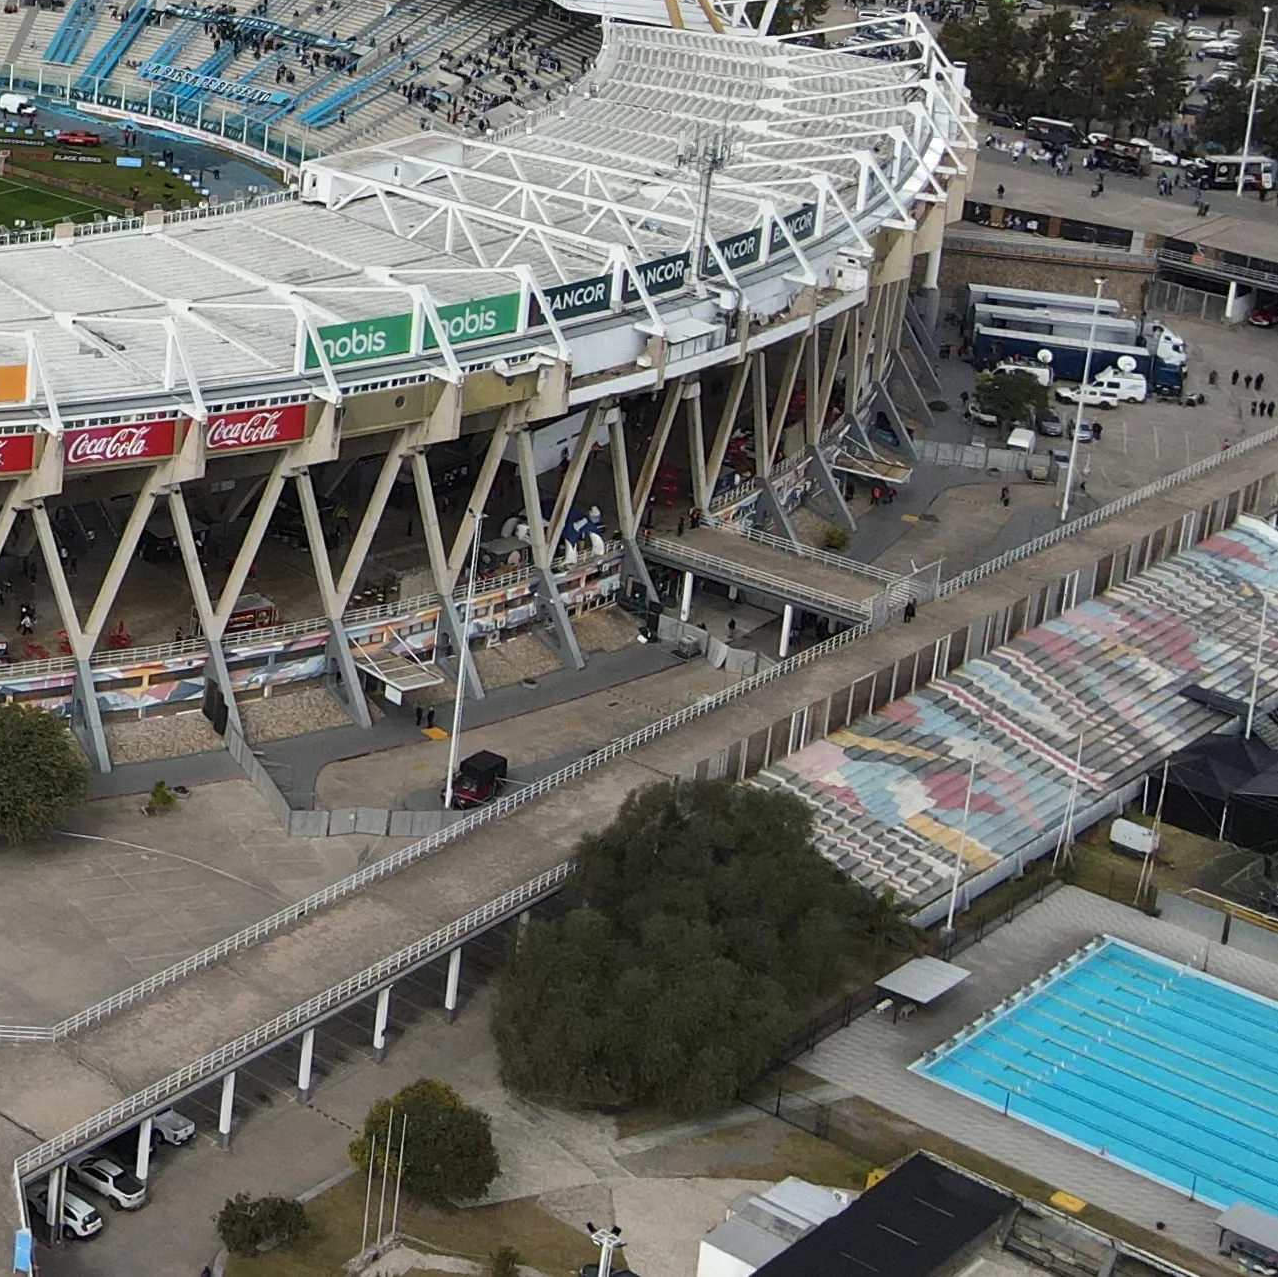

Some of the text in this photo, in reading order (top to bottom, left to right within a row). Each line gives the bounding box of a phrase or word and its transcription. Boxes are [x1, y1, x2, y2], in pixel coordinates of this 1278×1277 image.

[774, 212, 813, 242] BNCOR
[707, 237, 755, 268] BNCOR
[68, 426, 151, 463] Coca-Cola
[206, 411, 282, 448] Coca-Cola
